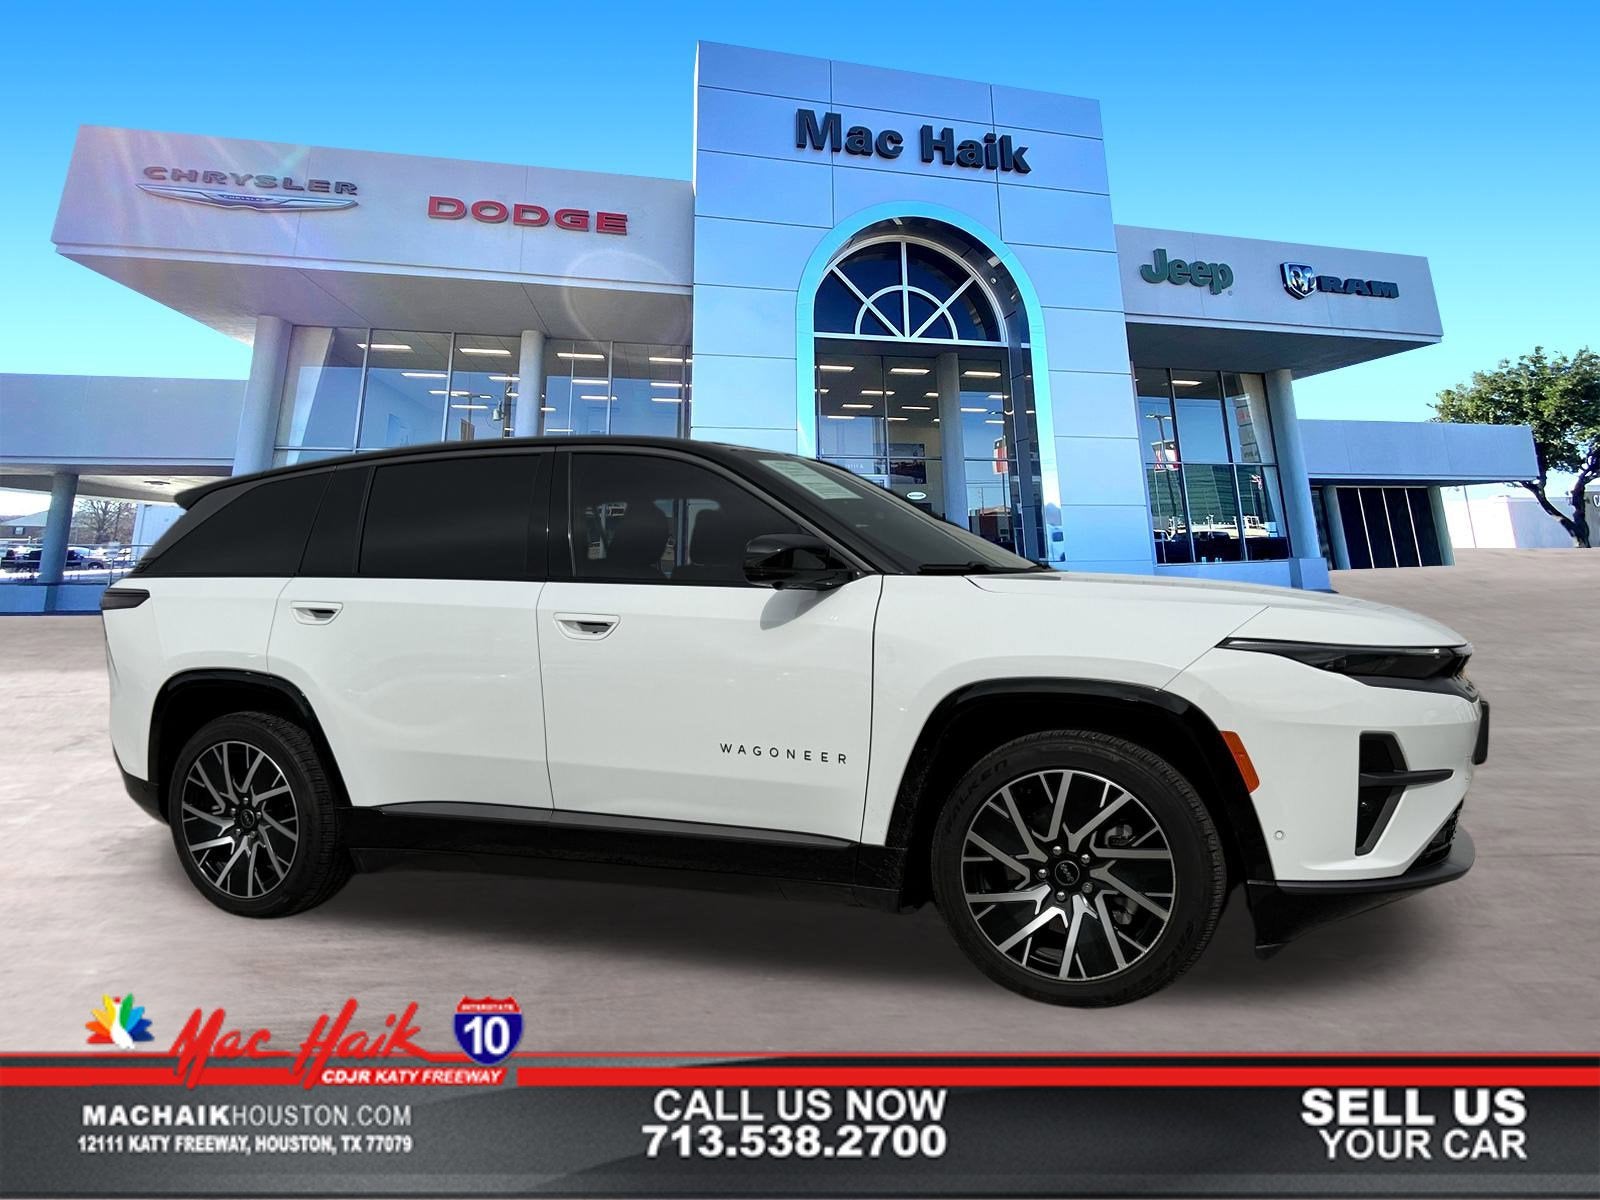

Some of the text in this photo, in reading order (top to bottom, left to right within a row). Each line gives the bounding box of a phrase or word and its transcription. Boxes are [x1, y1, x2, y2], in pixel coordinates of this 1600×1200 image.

[796, 108, 1032, 175] Mac Haik
[143, 166, 359, 196] CHRYSLER
[427, 196, 629, 236] DODGE
[1139, 248, 1235, 296] Jeep
[1314, 275, 1400, 299] RAM
[719, 742, 848, 765] WAGONEER
